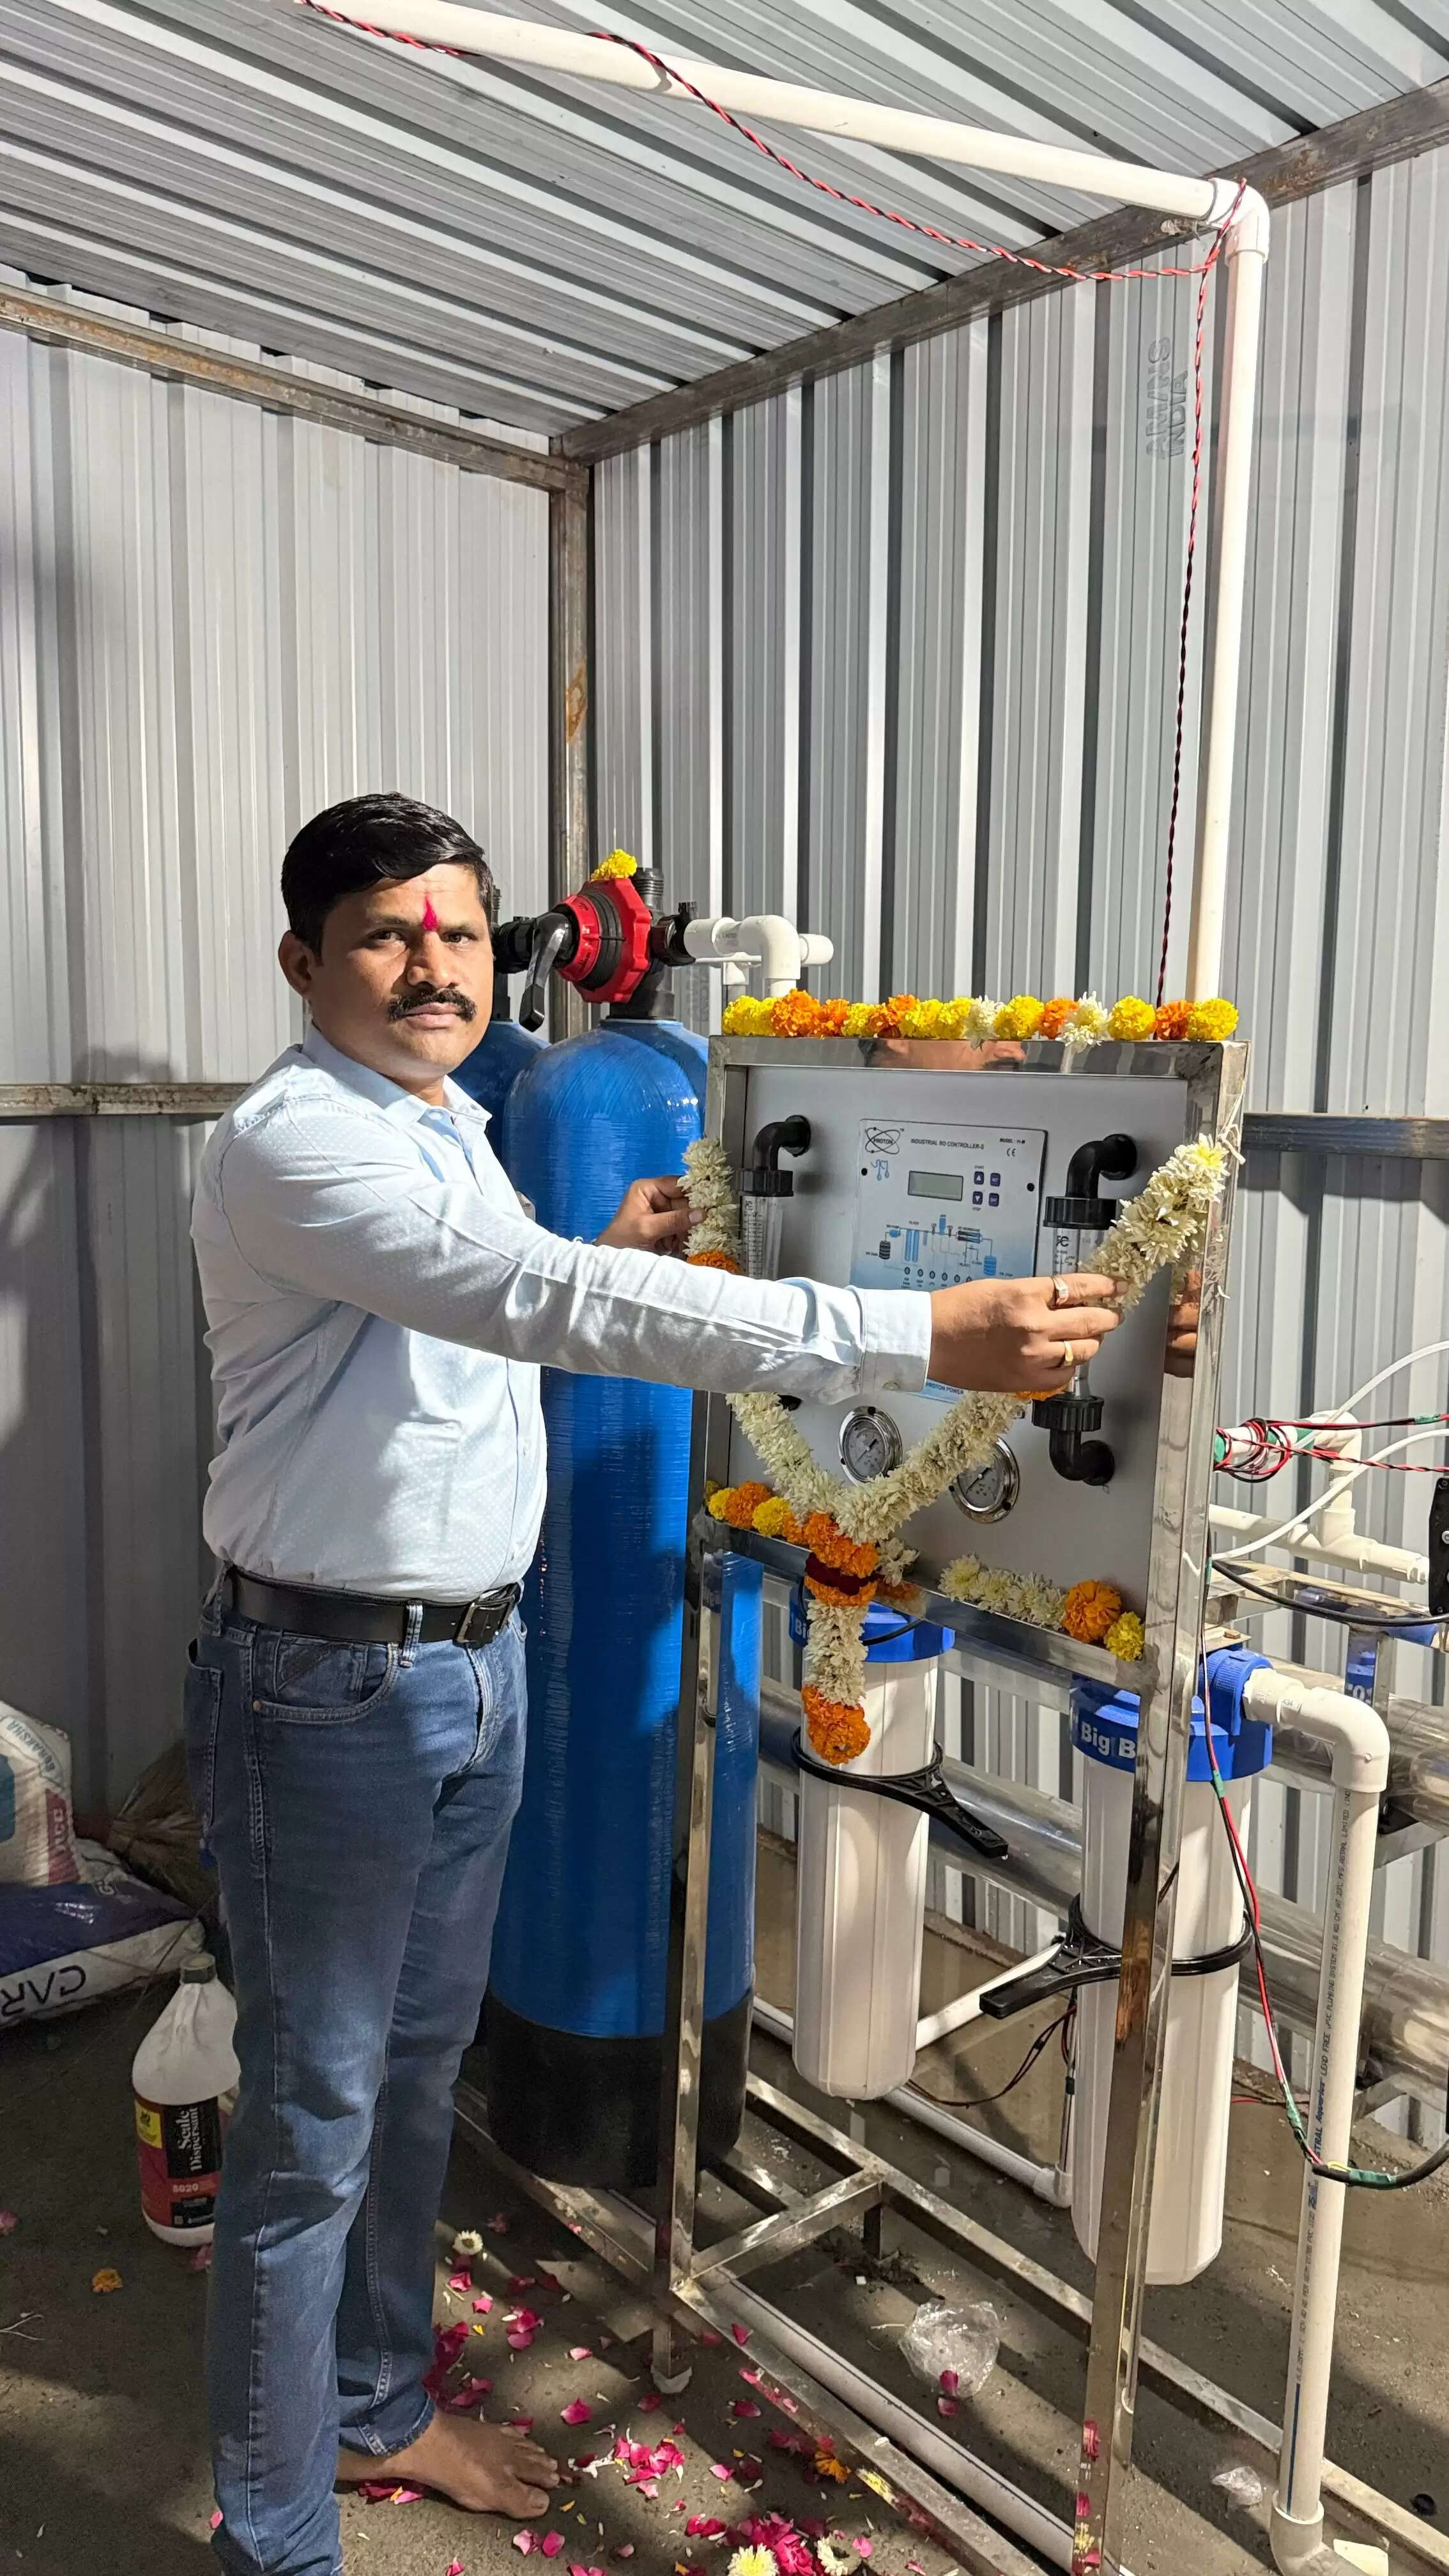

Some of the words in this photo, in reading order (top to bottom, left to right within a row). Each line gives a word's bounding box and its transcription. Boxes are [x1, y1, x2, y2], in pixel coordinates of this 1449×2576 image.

[1168, 370, 1188, 457] INDIA
[795, 1617, 807, 1639] Bi
[1081, 1721, 1110, 1756] Big
[1118, 1737, 1137, 1759] B
[176, 2110, 192, 2149] Scale
[189, 2106, 203, 2171] Dispersant
